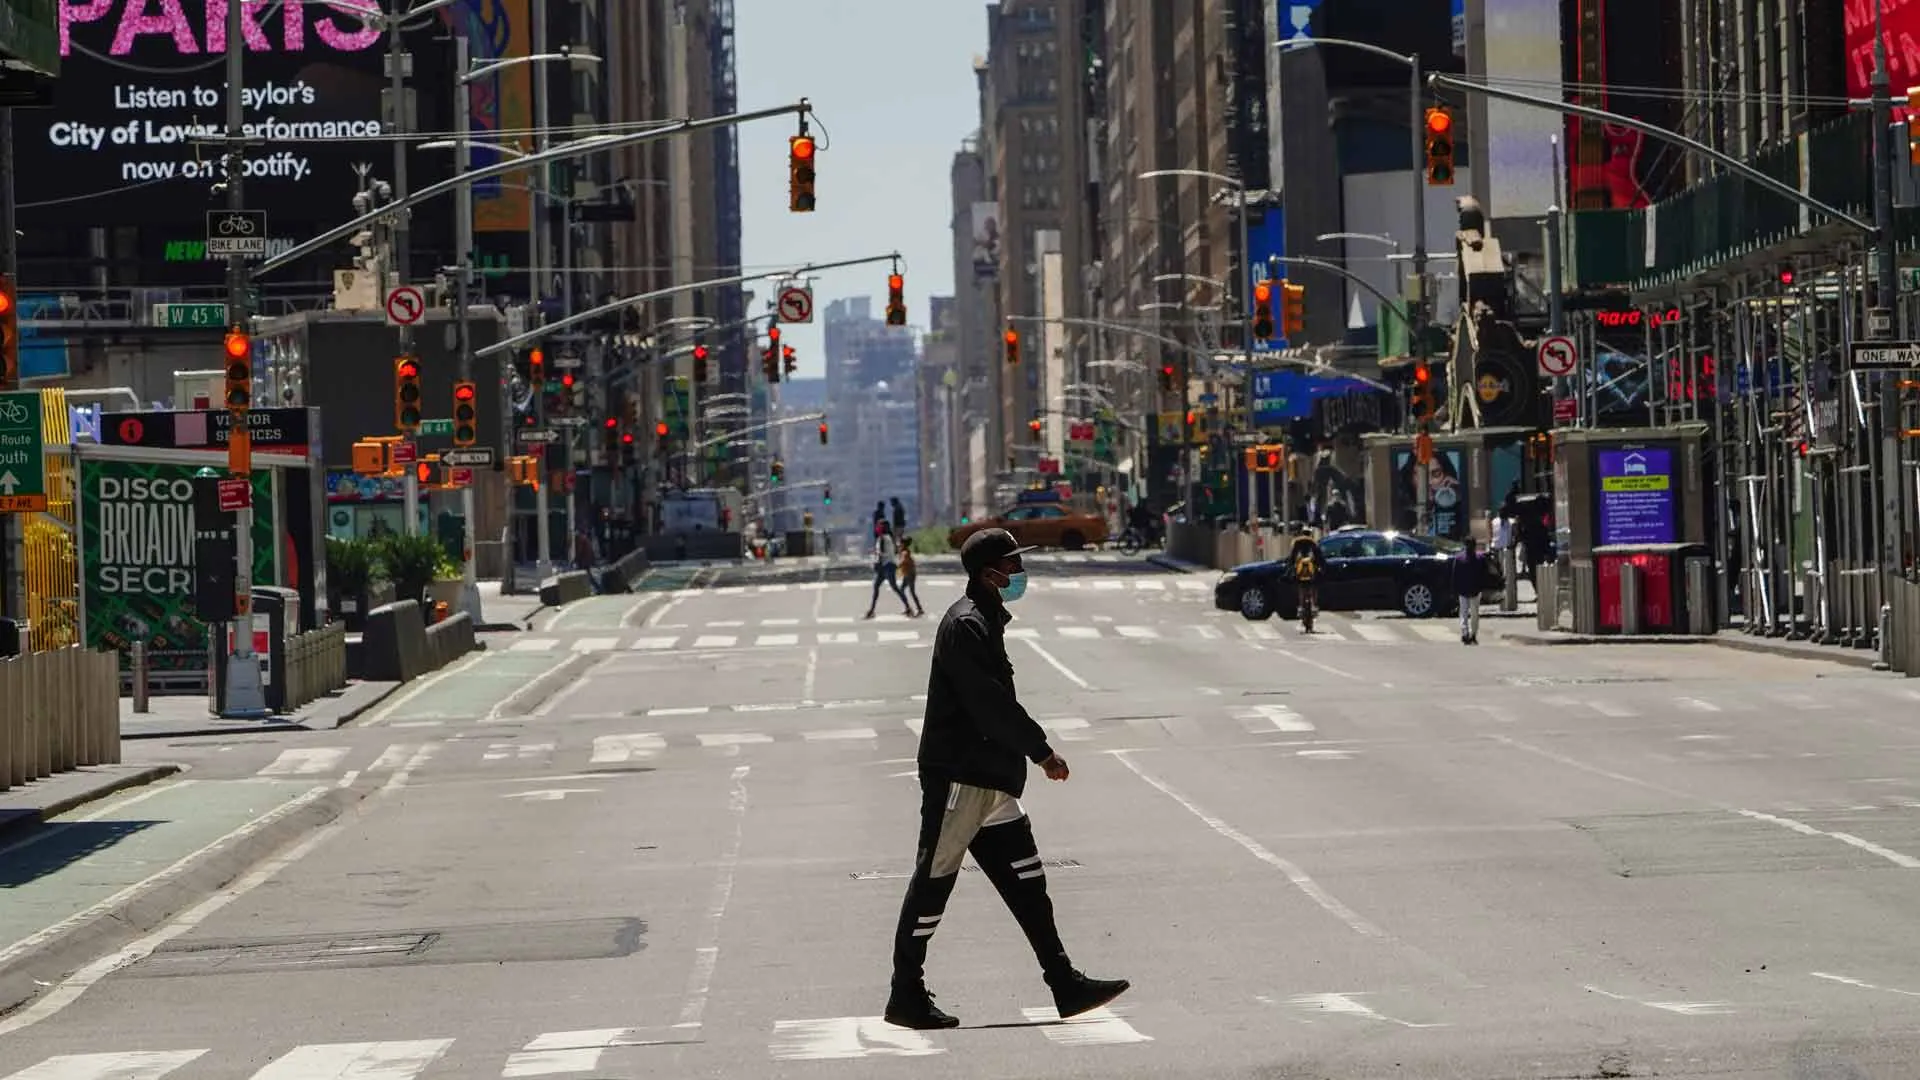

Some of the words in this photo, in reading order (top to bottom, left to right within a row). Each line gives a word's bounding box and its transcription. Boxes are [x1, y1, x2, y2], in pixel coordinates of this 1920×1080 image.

[59, 0, 384, 55] PARIS
[114, 85, 186, 109] Listen
[193, 86, 219, 107] to
[224, 80, 316, 111] aylor's
[49, 122, 105, 150] City
[111, 121, 139, 144] of
[225, 116, 381, 139] erformance
[122, 161, 176, 180] now
[182, 160, 214, 178] on
[211, 240, 232, 250] BIKE
[237, 240, 263, 250] LANE
[171, 307, 184, 324] W
[191, 307, 208, 324] 45
[1862, 350, 1888, 362] ONE
[1896, 350, 1920, 362] WAY
[1, 434, 31, 447] Route
[0, 449, 28, 465] outh
[100, 477, 194, 500] DISCO
